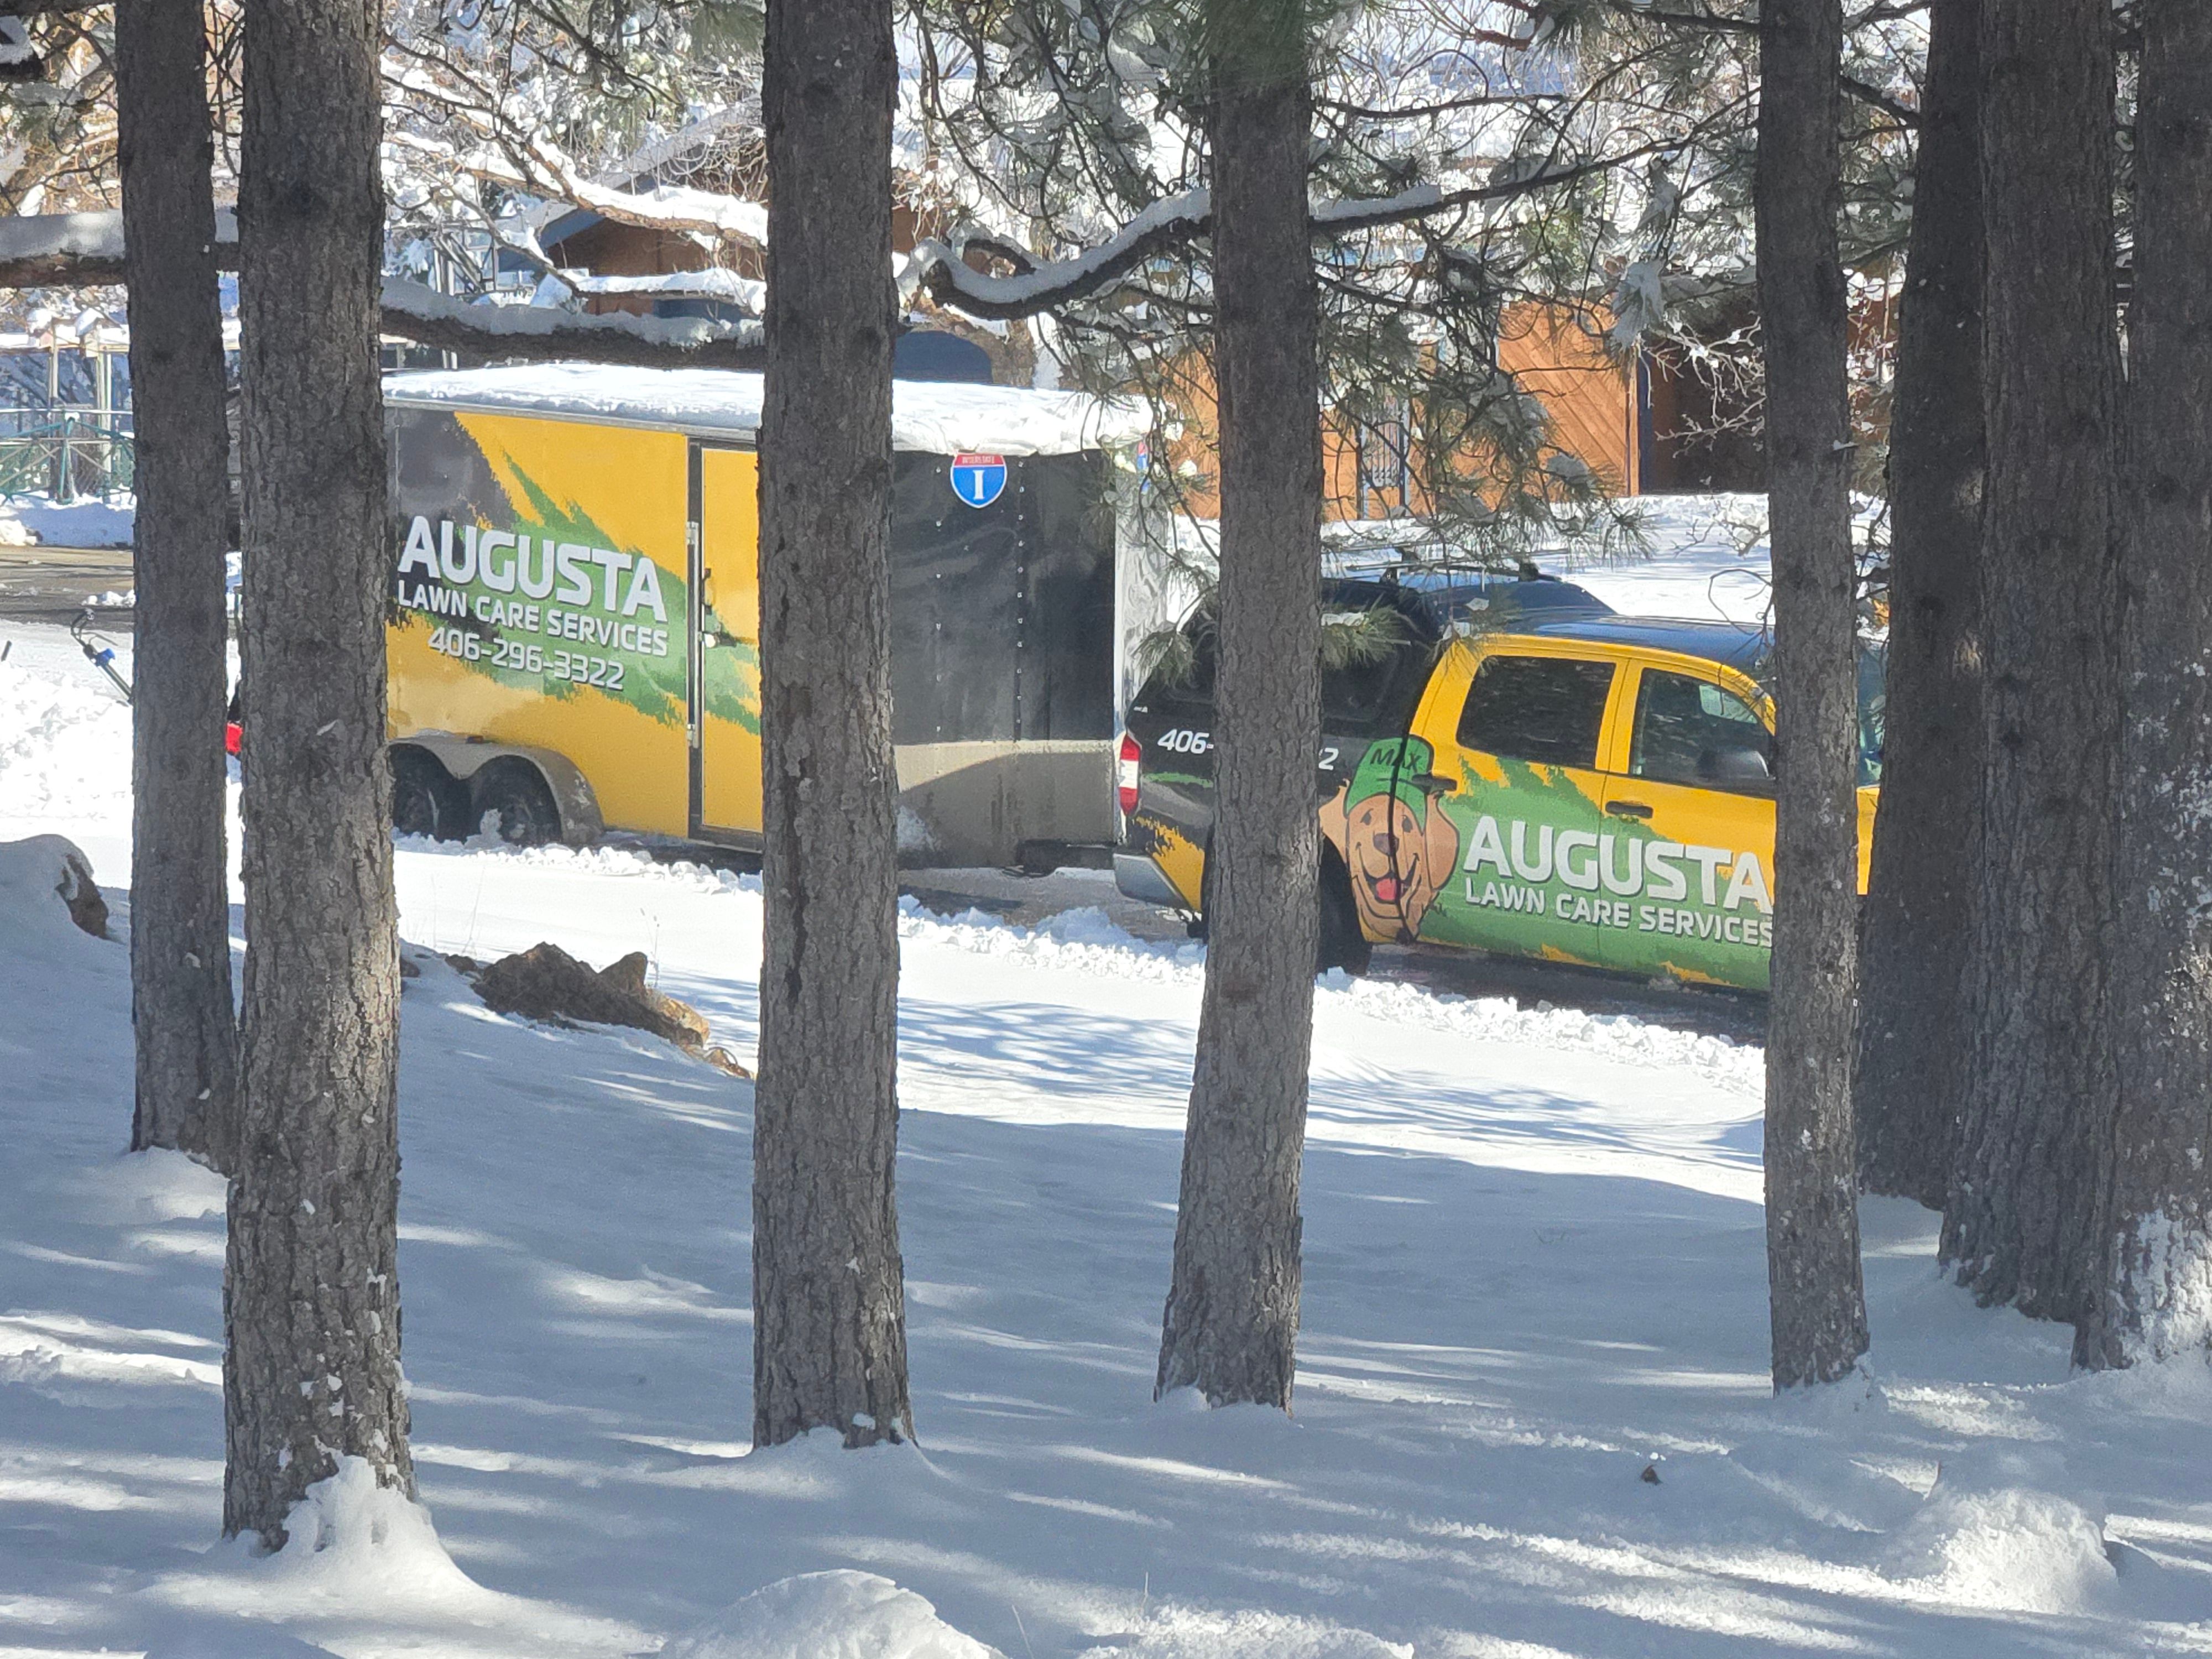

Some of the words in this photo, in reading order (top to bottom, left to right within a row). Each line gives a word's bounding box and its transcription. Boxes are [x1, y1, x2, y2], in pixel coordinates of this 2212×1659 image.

[397, 515, 668, 622] AUGUSTA
[398, 580, 467, 618] LAWN
[476, 596, 539, 632] CARE
[546, 609, 668, 656] SERVICES
[427, 627, 625, 690] 406-296-3322
[1463, 815, 1773, 915] AUGUSTA
[1465, 878, 1545, 914] LAWN
[1555, 894, 1630, 928] CARE
[1639, 906, 1772, 948] SERVICES
